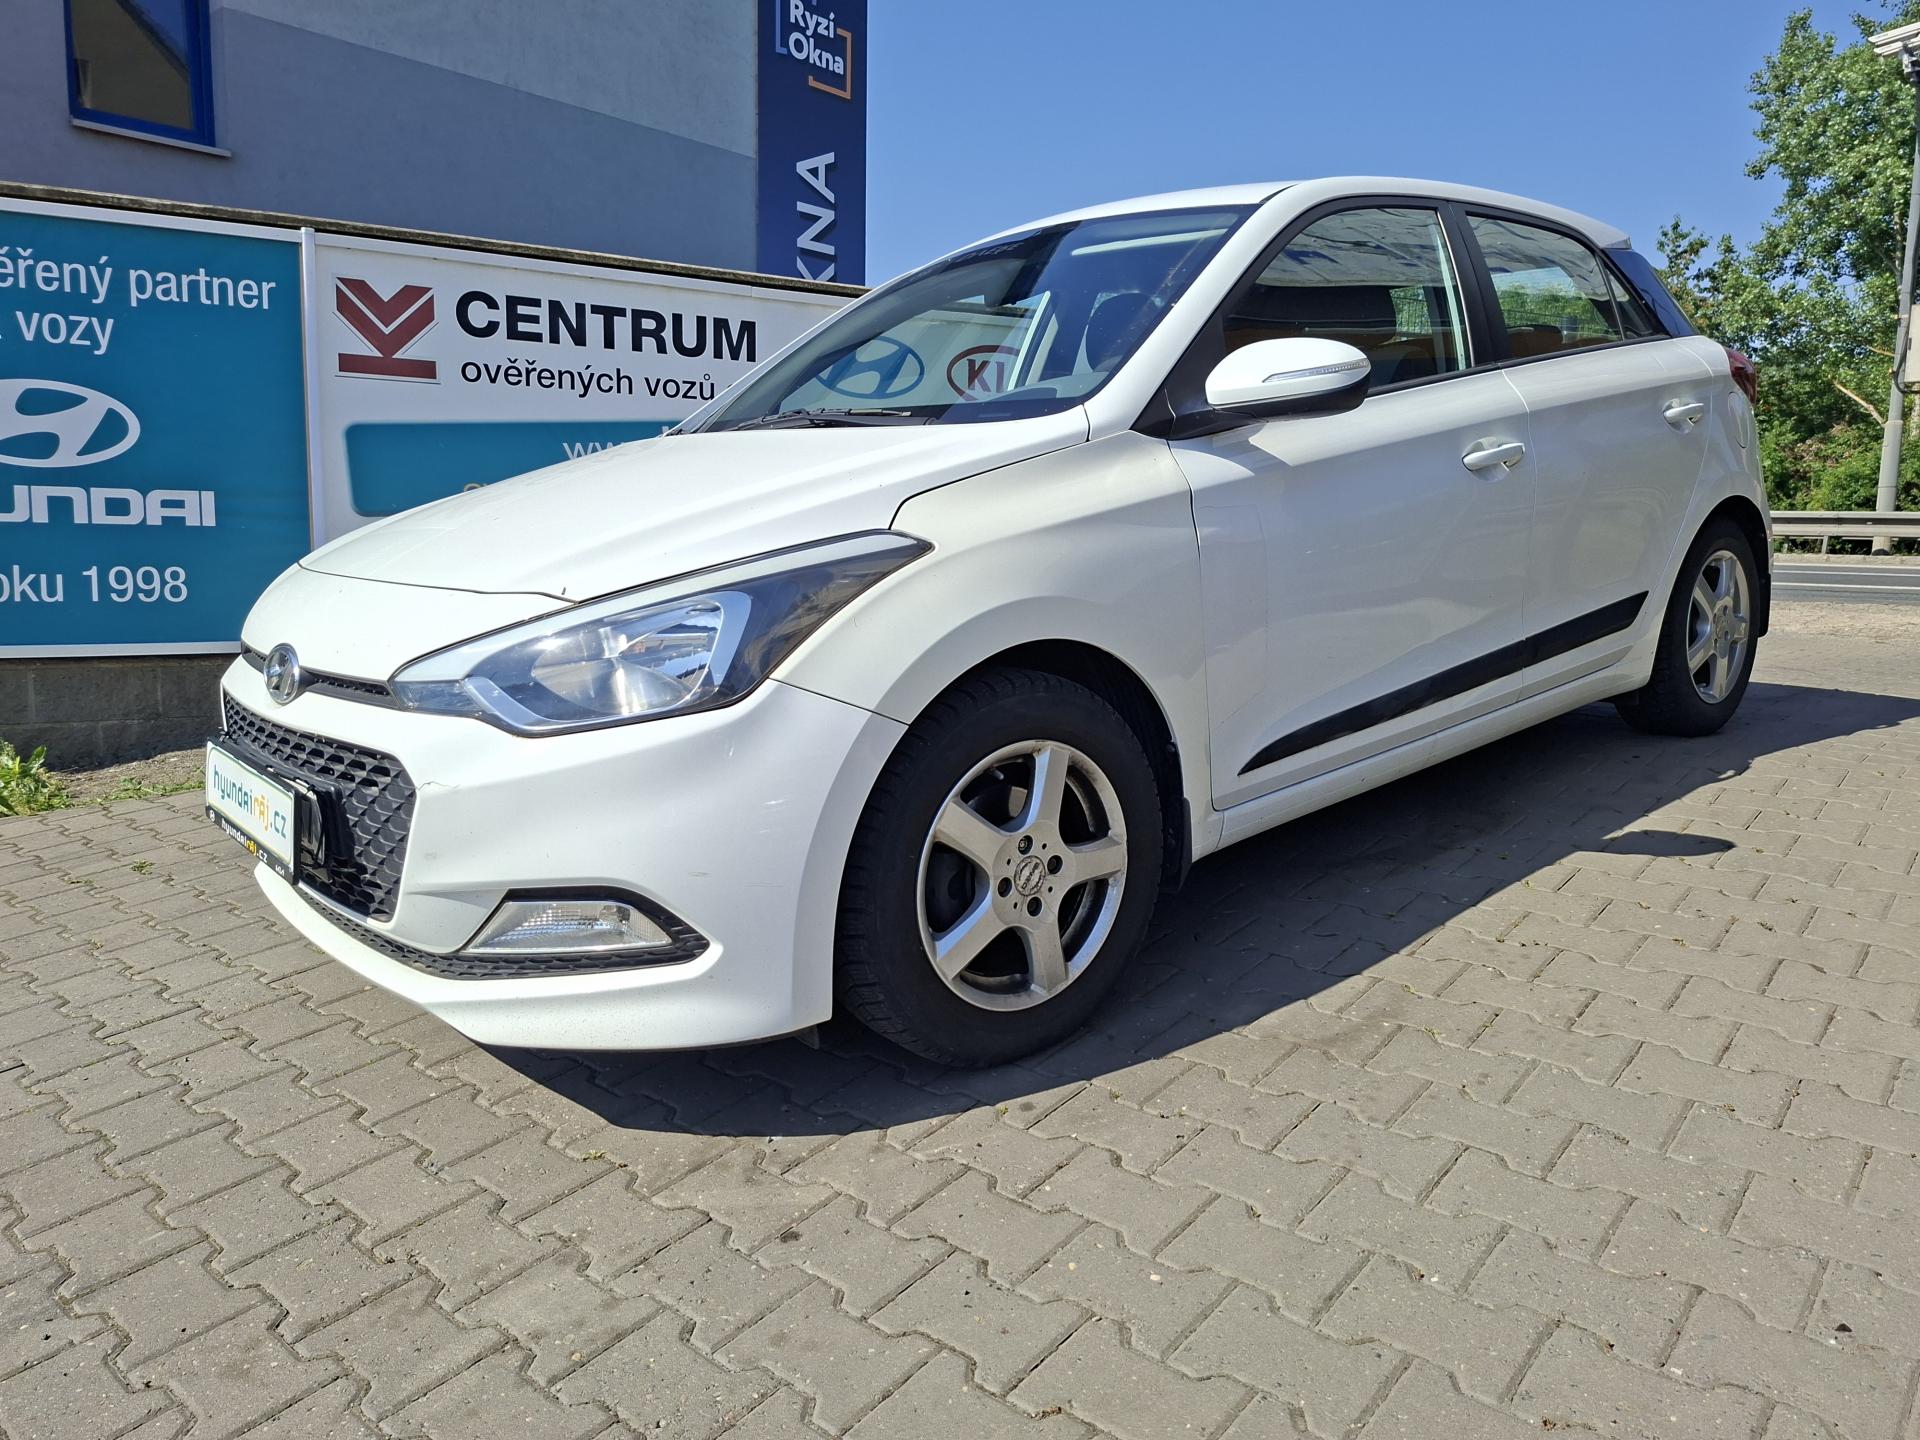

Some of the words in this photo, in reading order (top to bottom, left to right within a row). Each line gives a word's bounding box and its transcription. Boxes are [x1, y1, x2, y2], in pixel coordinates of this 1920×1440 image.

[788, 32, 844, 75] Okna
[129, 267, 277, 309] partner
[15, 310, 114, 354] vozy
[455, 290, 757, 363] CENTRUM
[461, 357, 633, 399] ověřených
[644, 373, 715, 401] vozů
[82, 565, 188, 603] 1998
